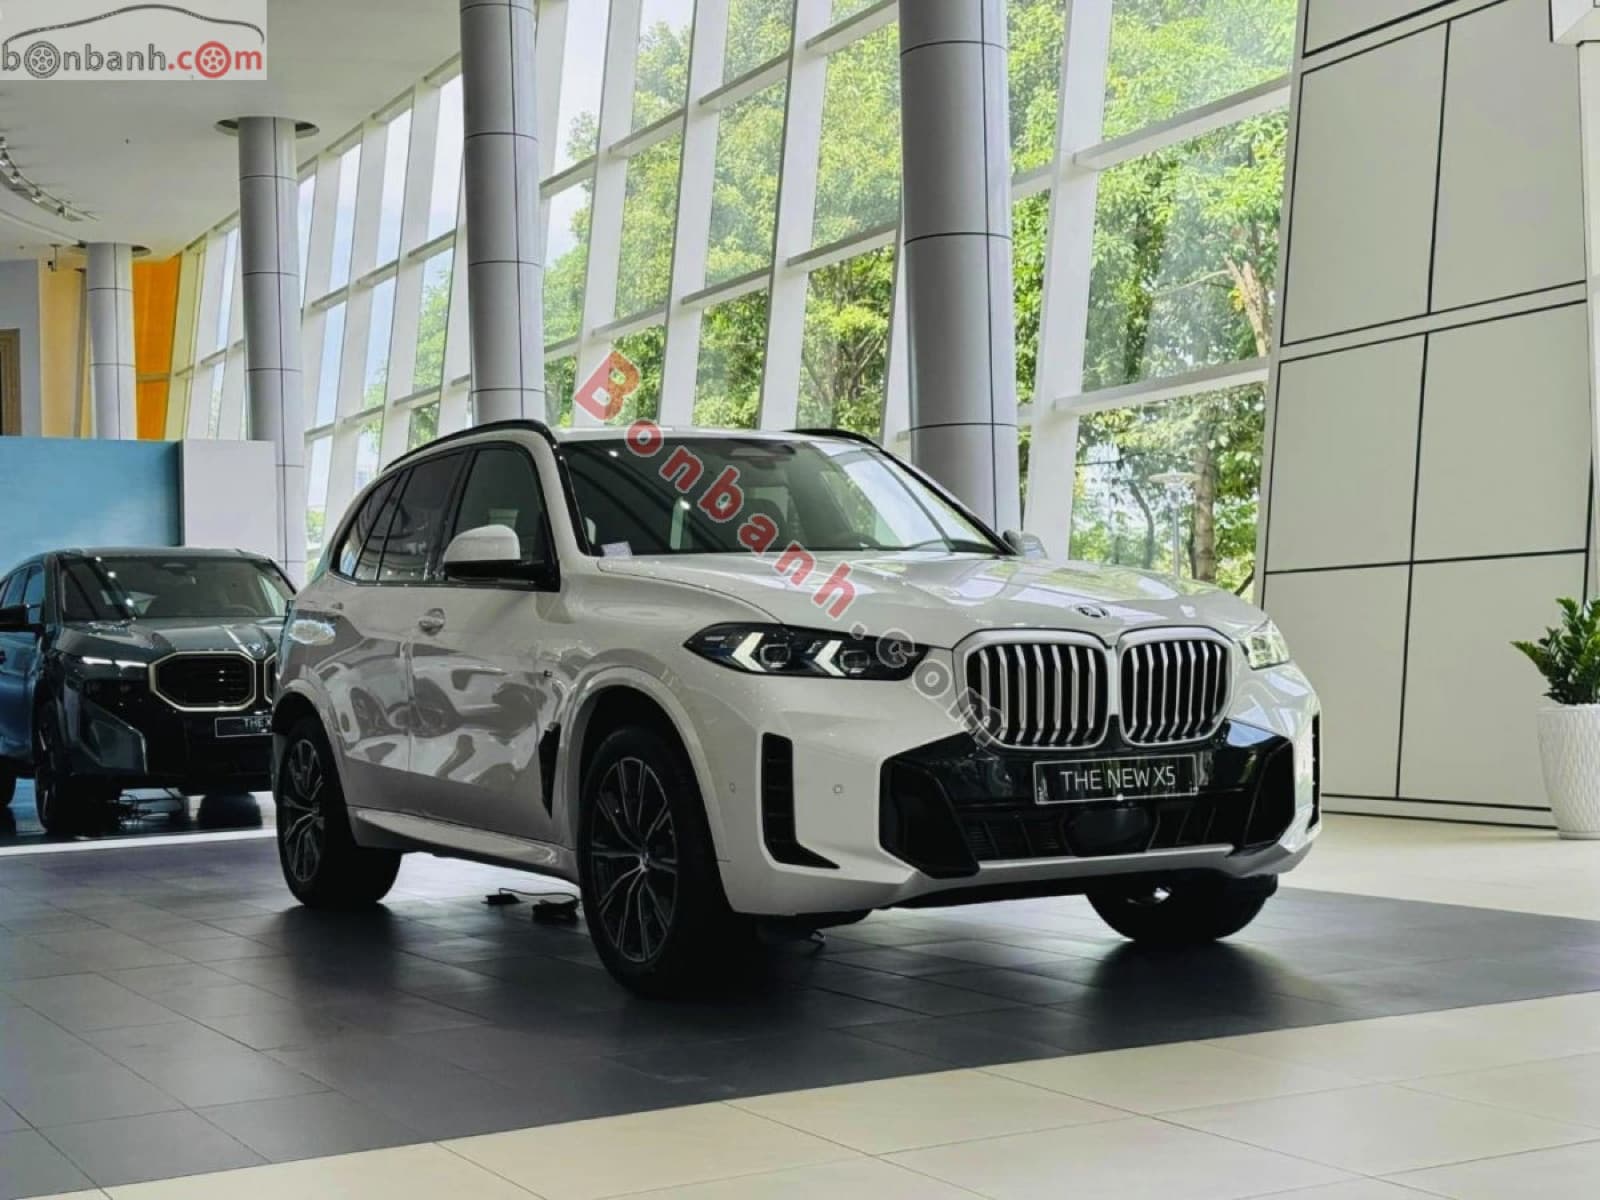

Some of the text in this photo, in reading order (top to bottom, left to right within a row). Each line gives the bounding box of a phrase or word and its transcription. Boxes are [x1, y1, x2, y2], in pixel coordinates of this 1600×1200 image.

[1060, 766, 1176, 792] THE NEW X5
